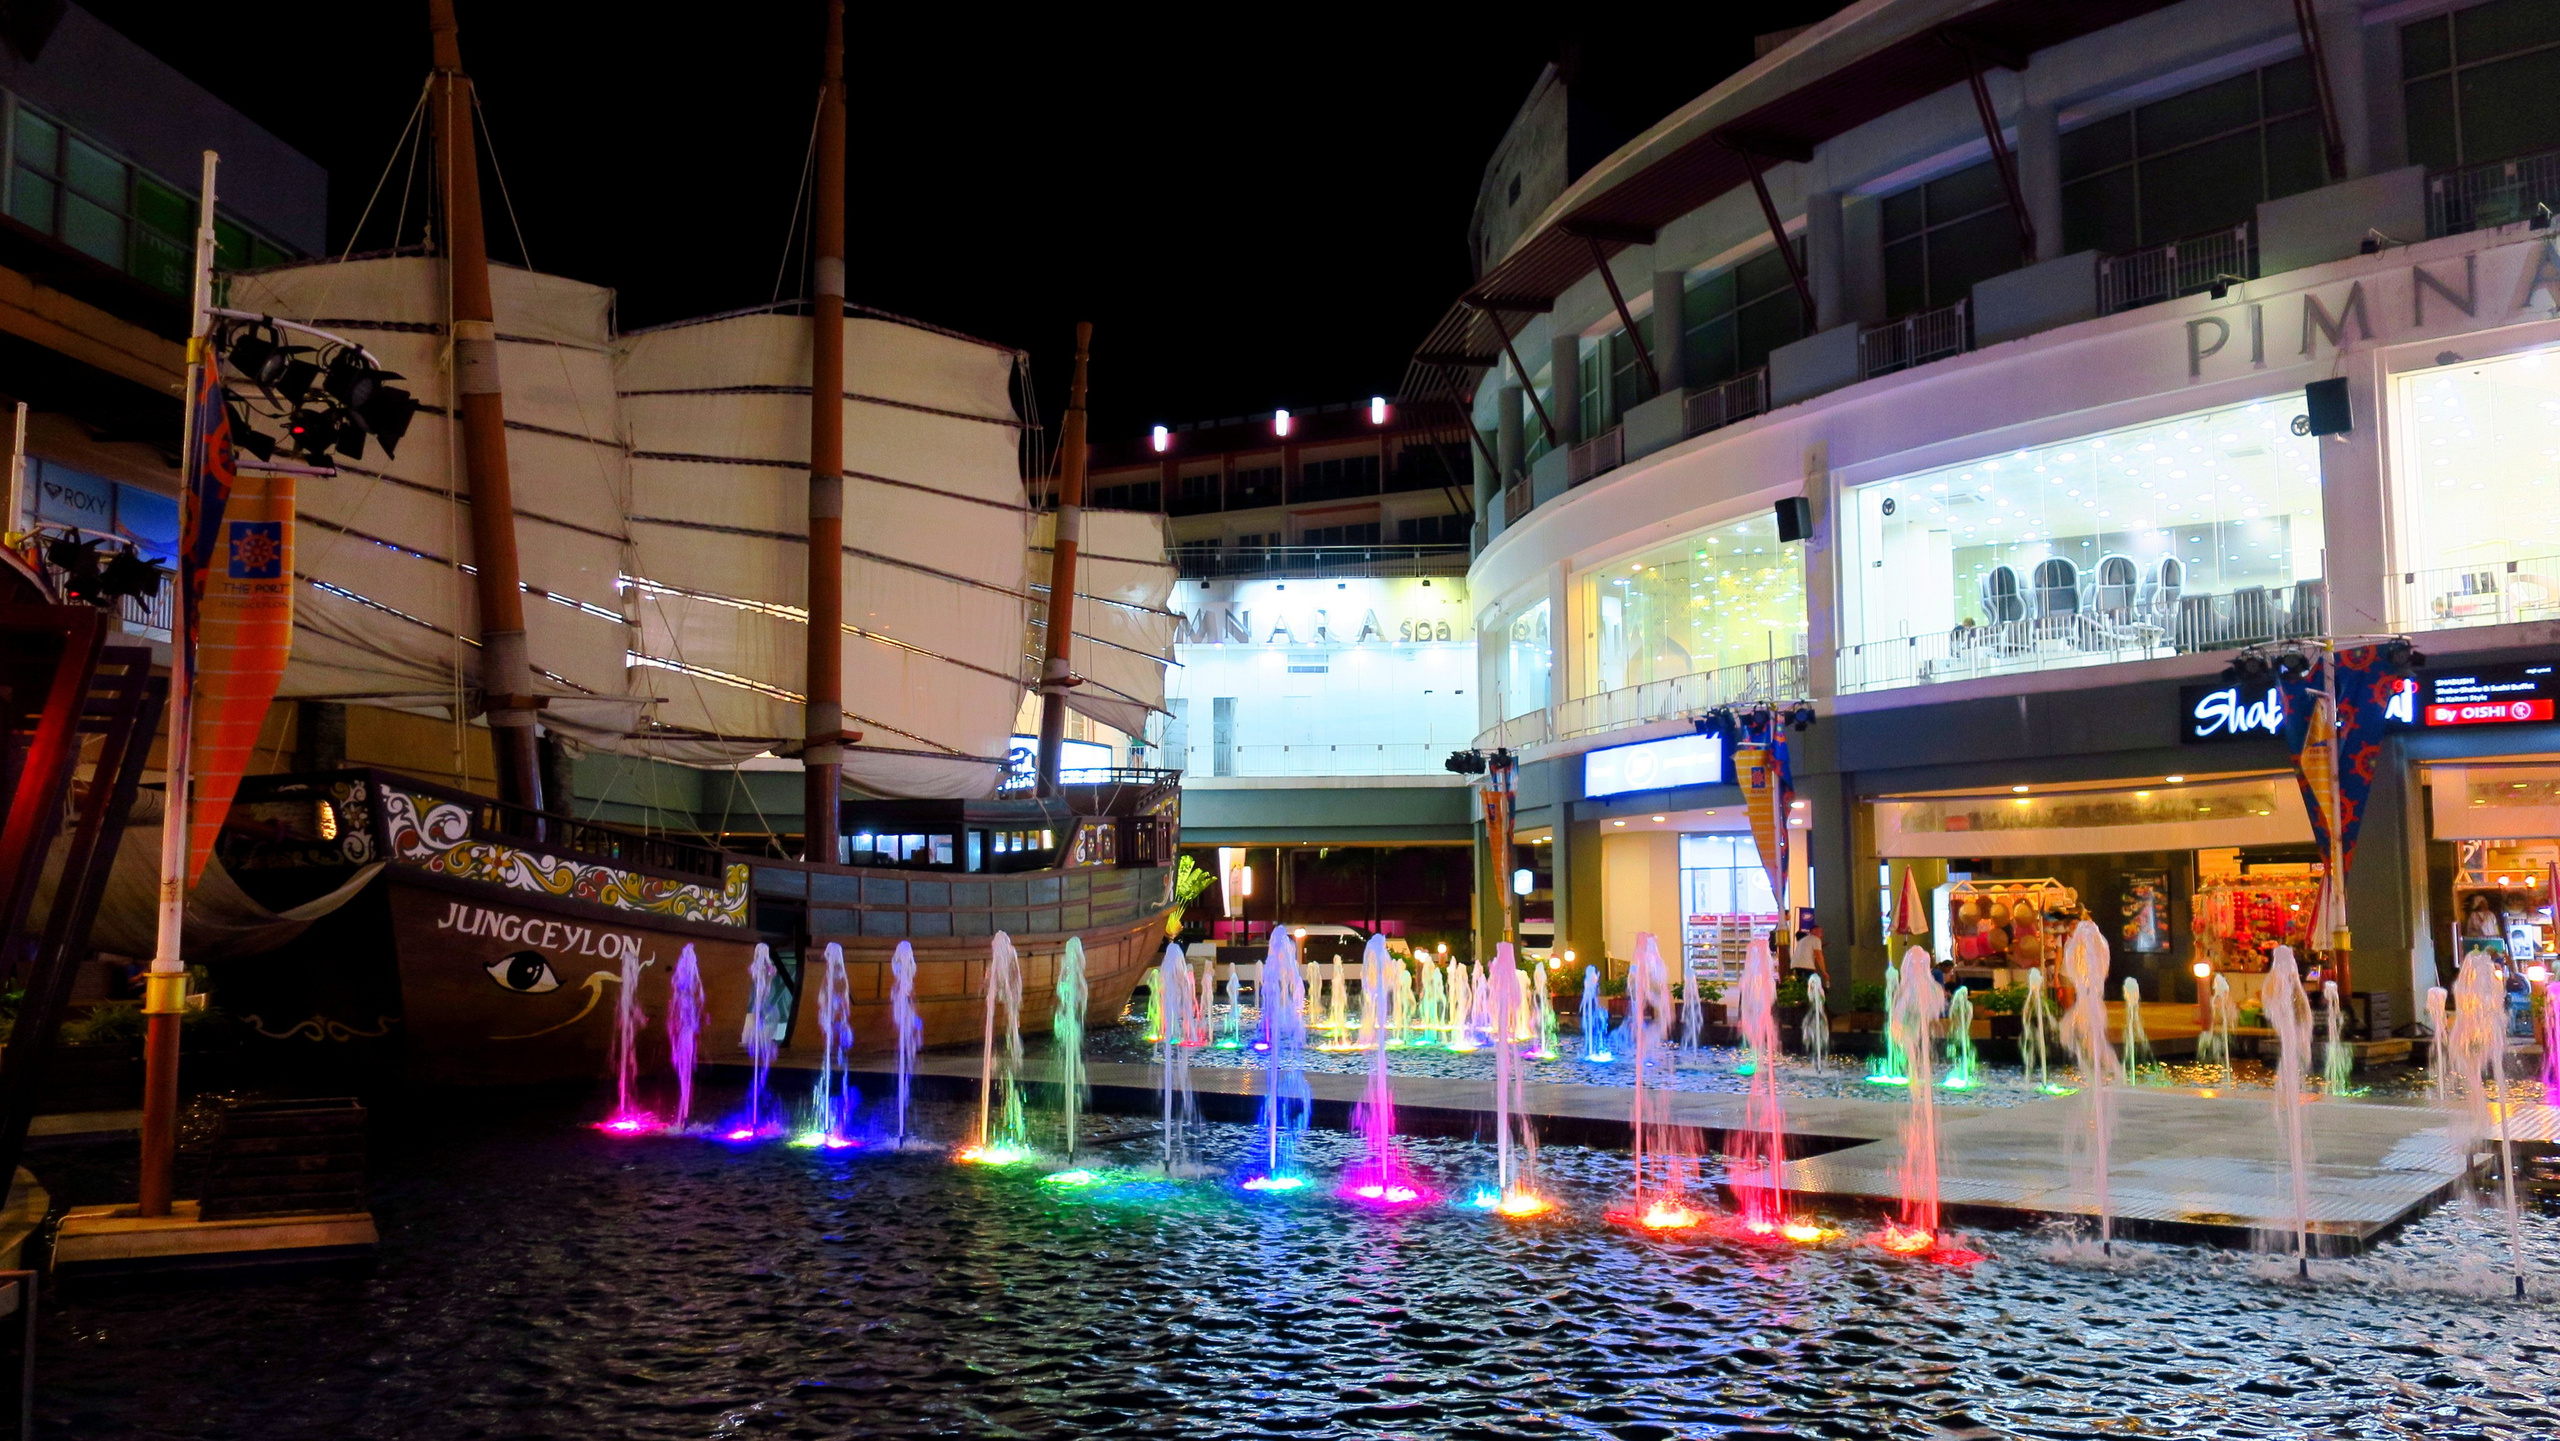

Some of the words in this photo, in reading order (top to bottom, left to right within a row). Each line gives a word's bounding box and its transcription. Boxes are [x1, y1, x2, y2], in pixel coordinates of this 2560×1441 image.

[2184, 239, 2560, 378] PIMNA
[63, 487, 107, 515] ROXY
[222, 582, 251, 594] THE
[254, 583, 290, 594] PORT
[1399, 616, 1451, 642] spa
[2435, 678, 2475, 687] SHABUSHI
[2435, 686, 2483, 695] Shabu-Shabu
[2490, 683, 2511, 692] Sushi
[2511, 683, 2535, 691] Buffet
[2469, 694, 2488, 702] Style
[2435, 708, 2457, 722] By
[2461, 705, 2506, 719] OISHI
[437, 902, 643, 960] JUNGCEYLON
